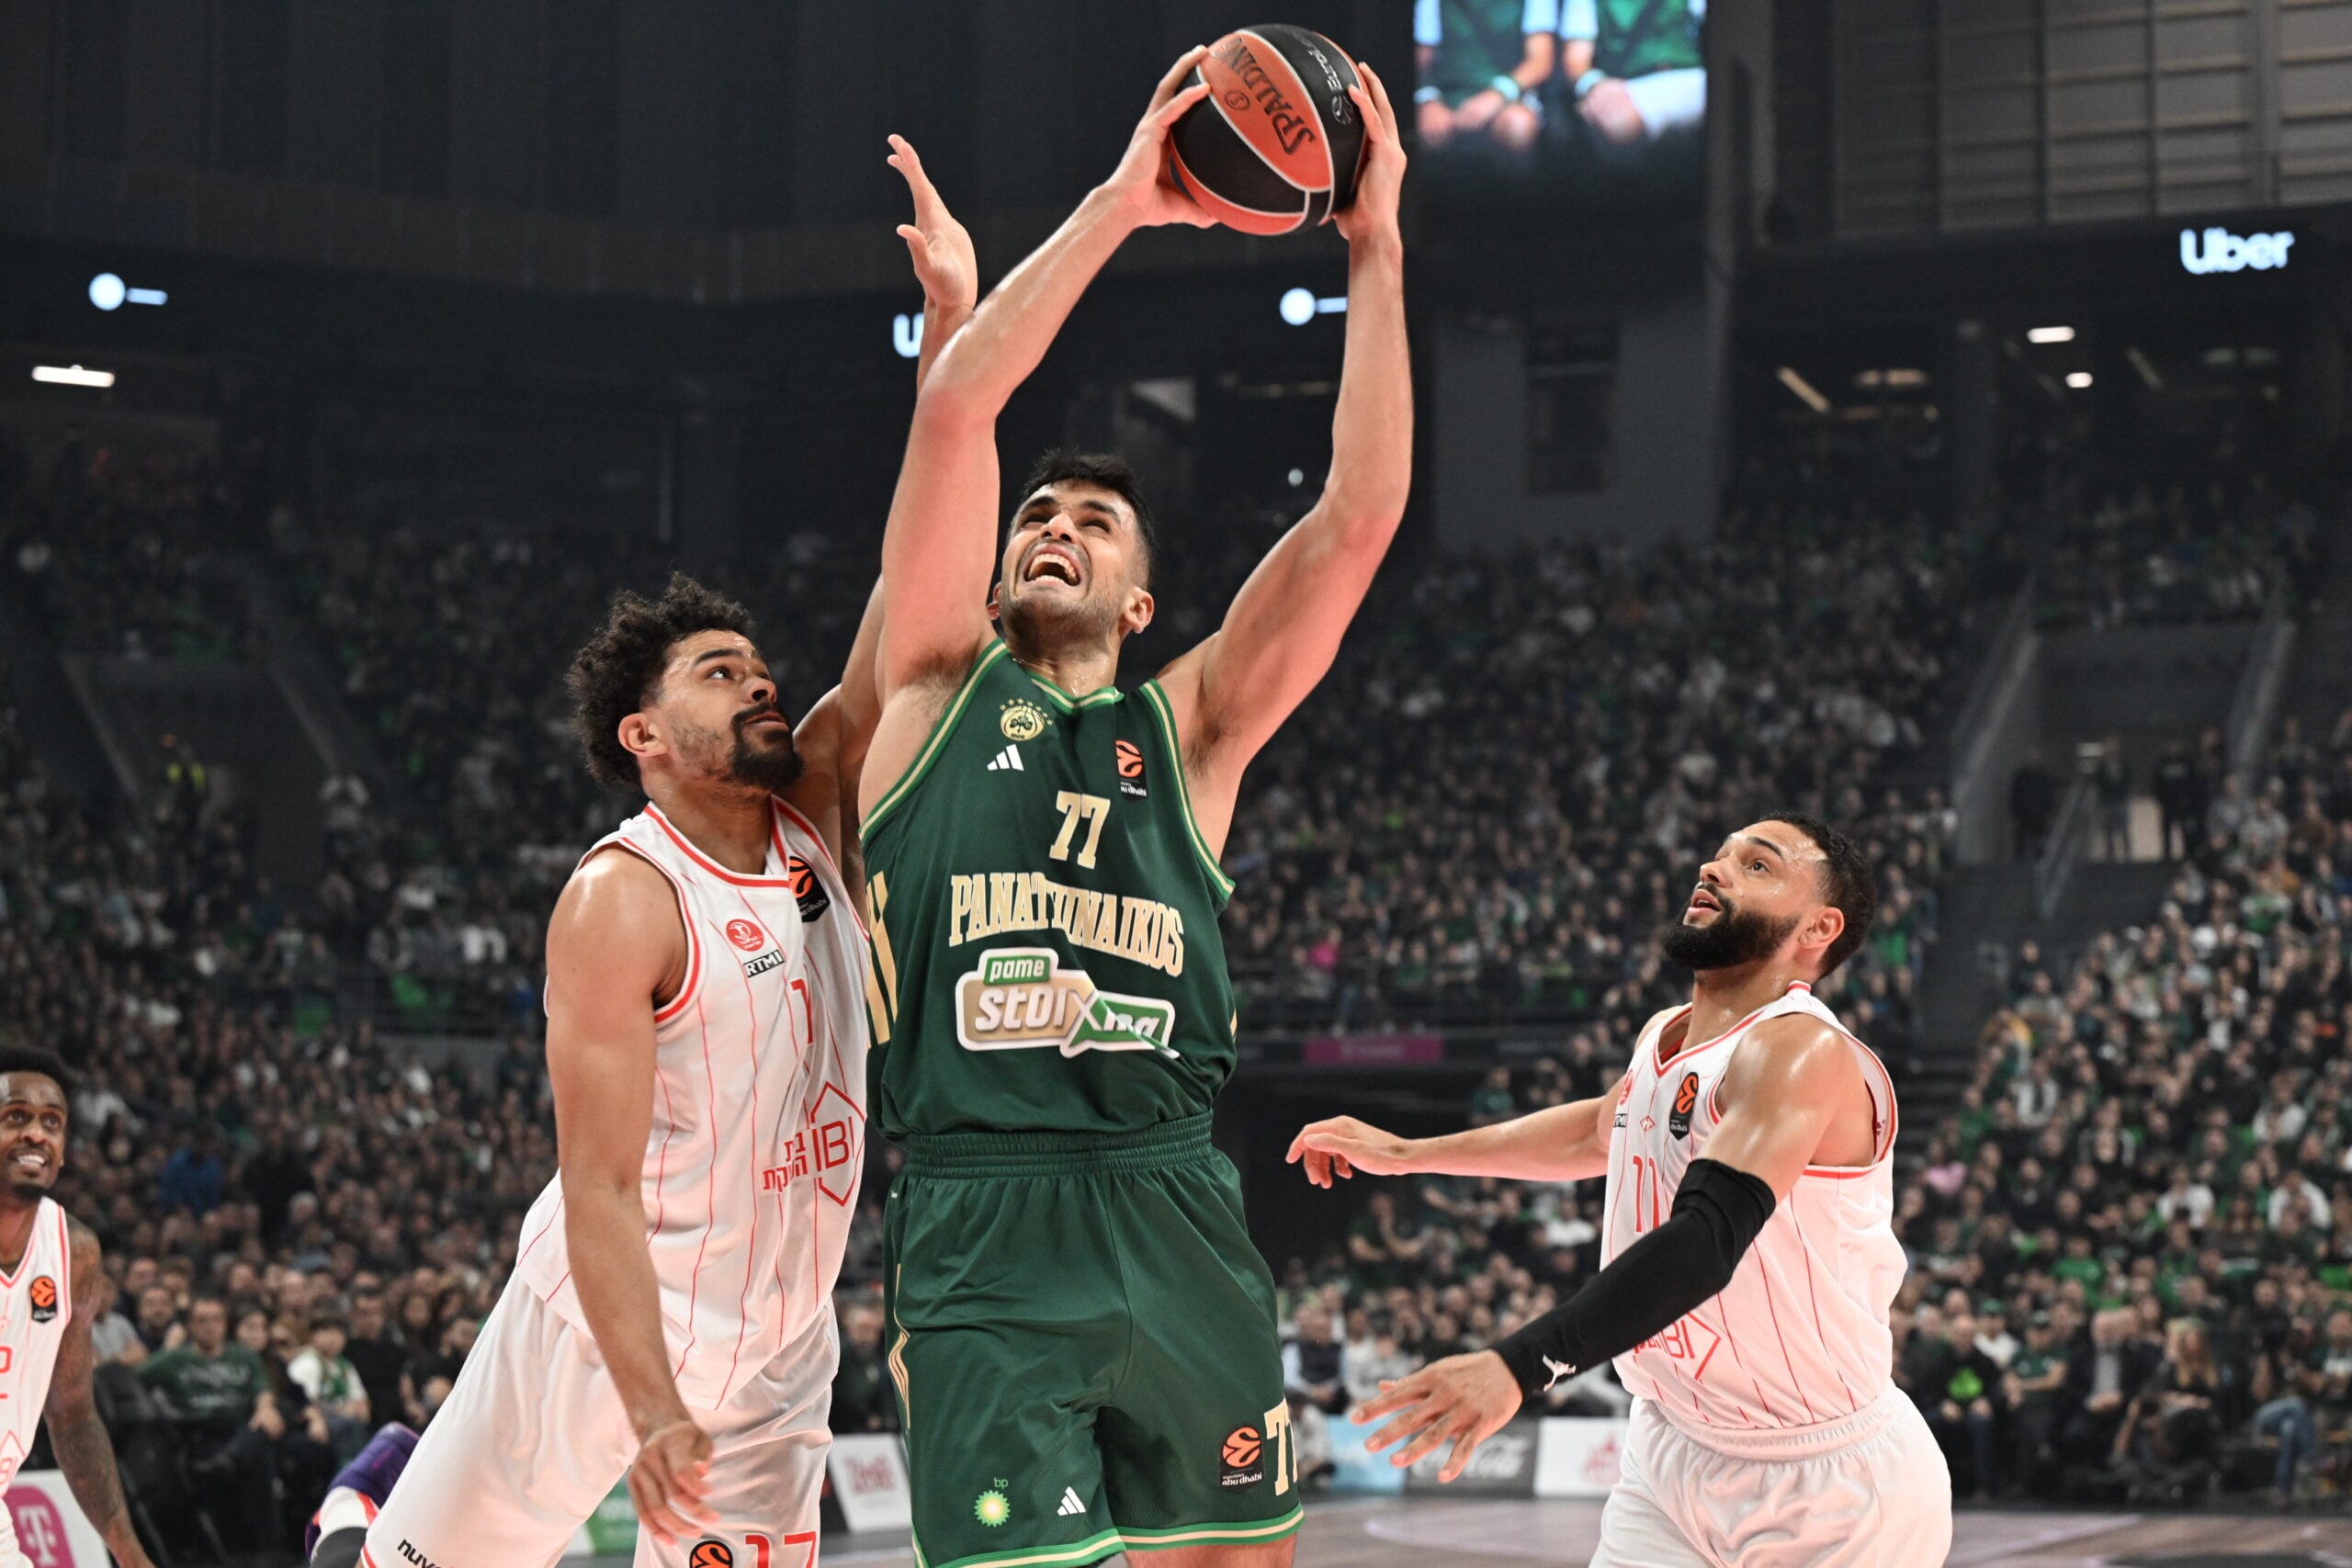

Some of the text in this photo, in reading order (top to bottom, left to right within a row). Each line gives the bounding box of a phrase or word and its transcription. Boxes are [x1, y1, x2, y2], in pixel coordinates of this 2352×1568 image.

[2180, 227, 2295, 275] Uber
[1049, 790, 1111, 870] 77
[743, 951, 784, 976] RTMI
[989, 960, 1046, 983] pame
[812, 1116, 855, 1173] IBI
[1633, 1156, 1660, 1233] 11
[994, 1477, 1009, 1489] bp
